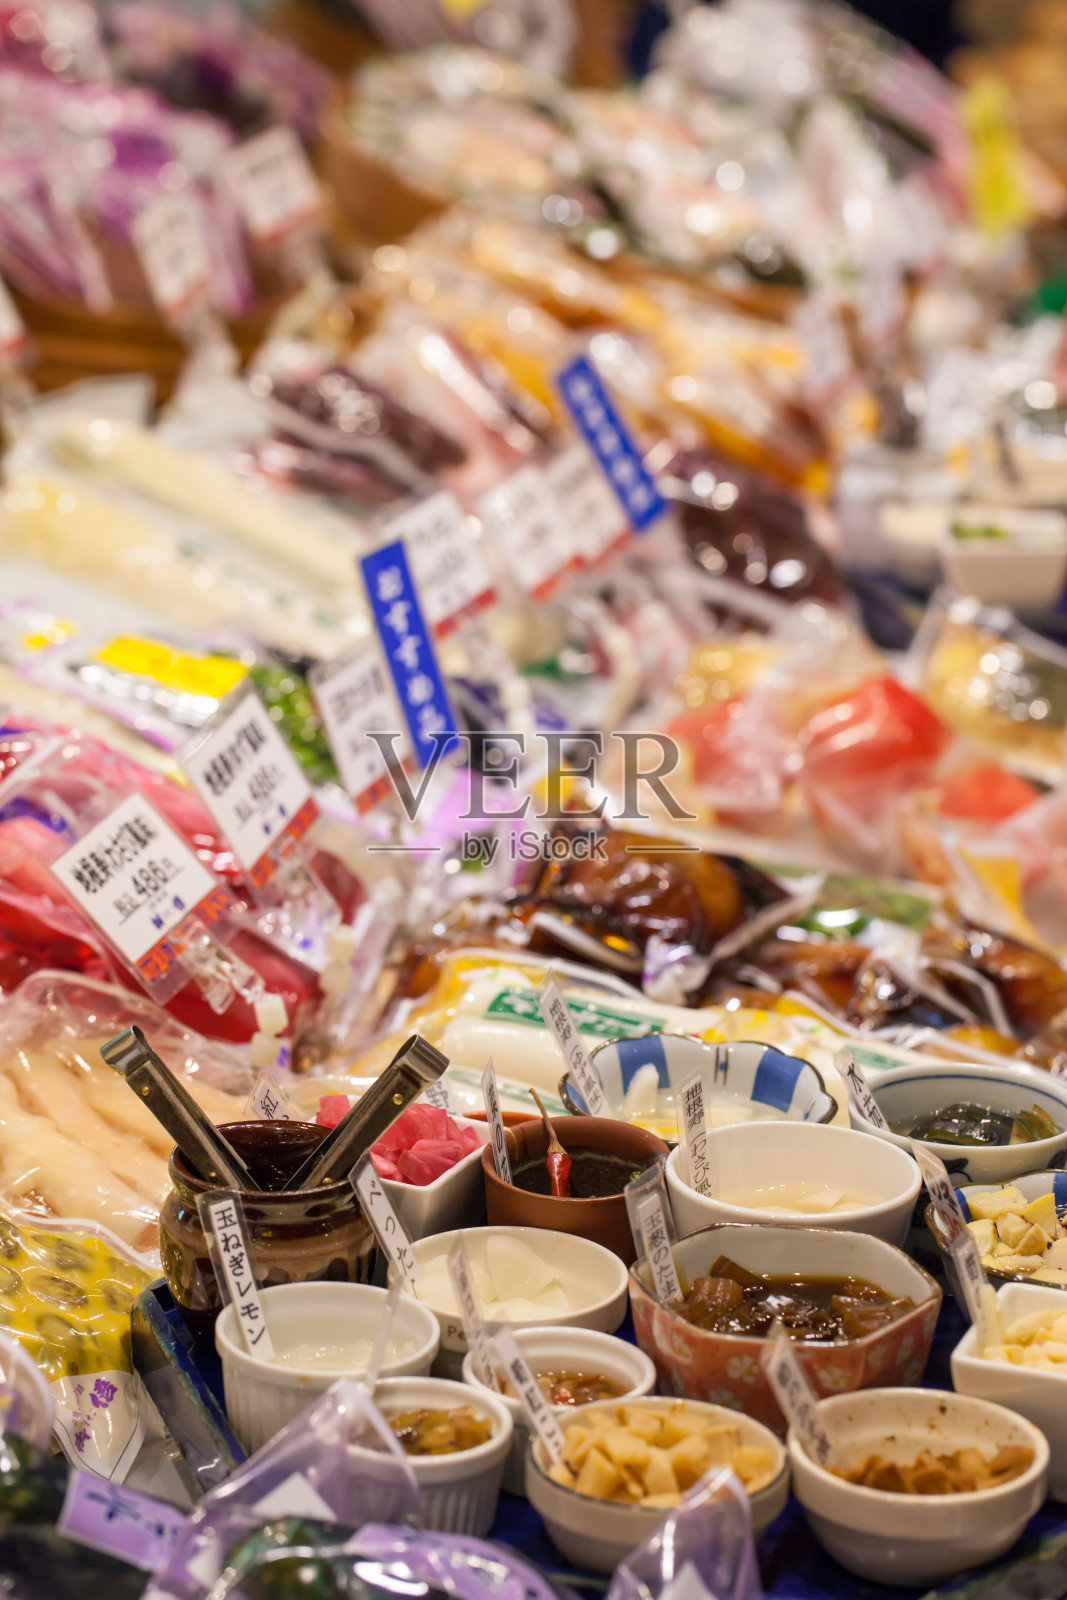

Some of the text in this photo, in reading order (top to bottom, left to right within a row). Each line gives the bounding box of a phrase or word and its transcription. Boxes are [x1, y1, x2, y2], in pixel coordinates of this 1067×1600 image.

[214, 1207, 266, 1345] 玉ねぎレモン
